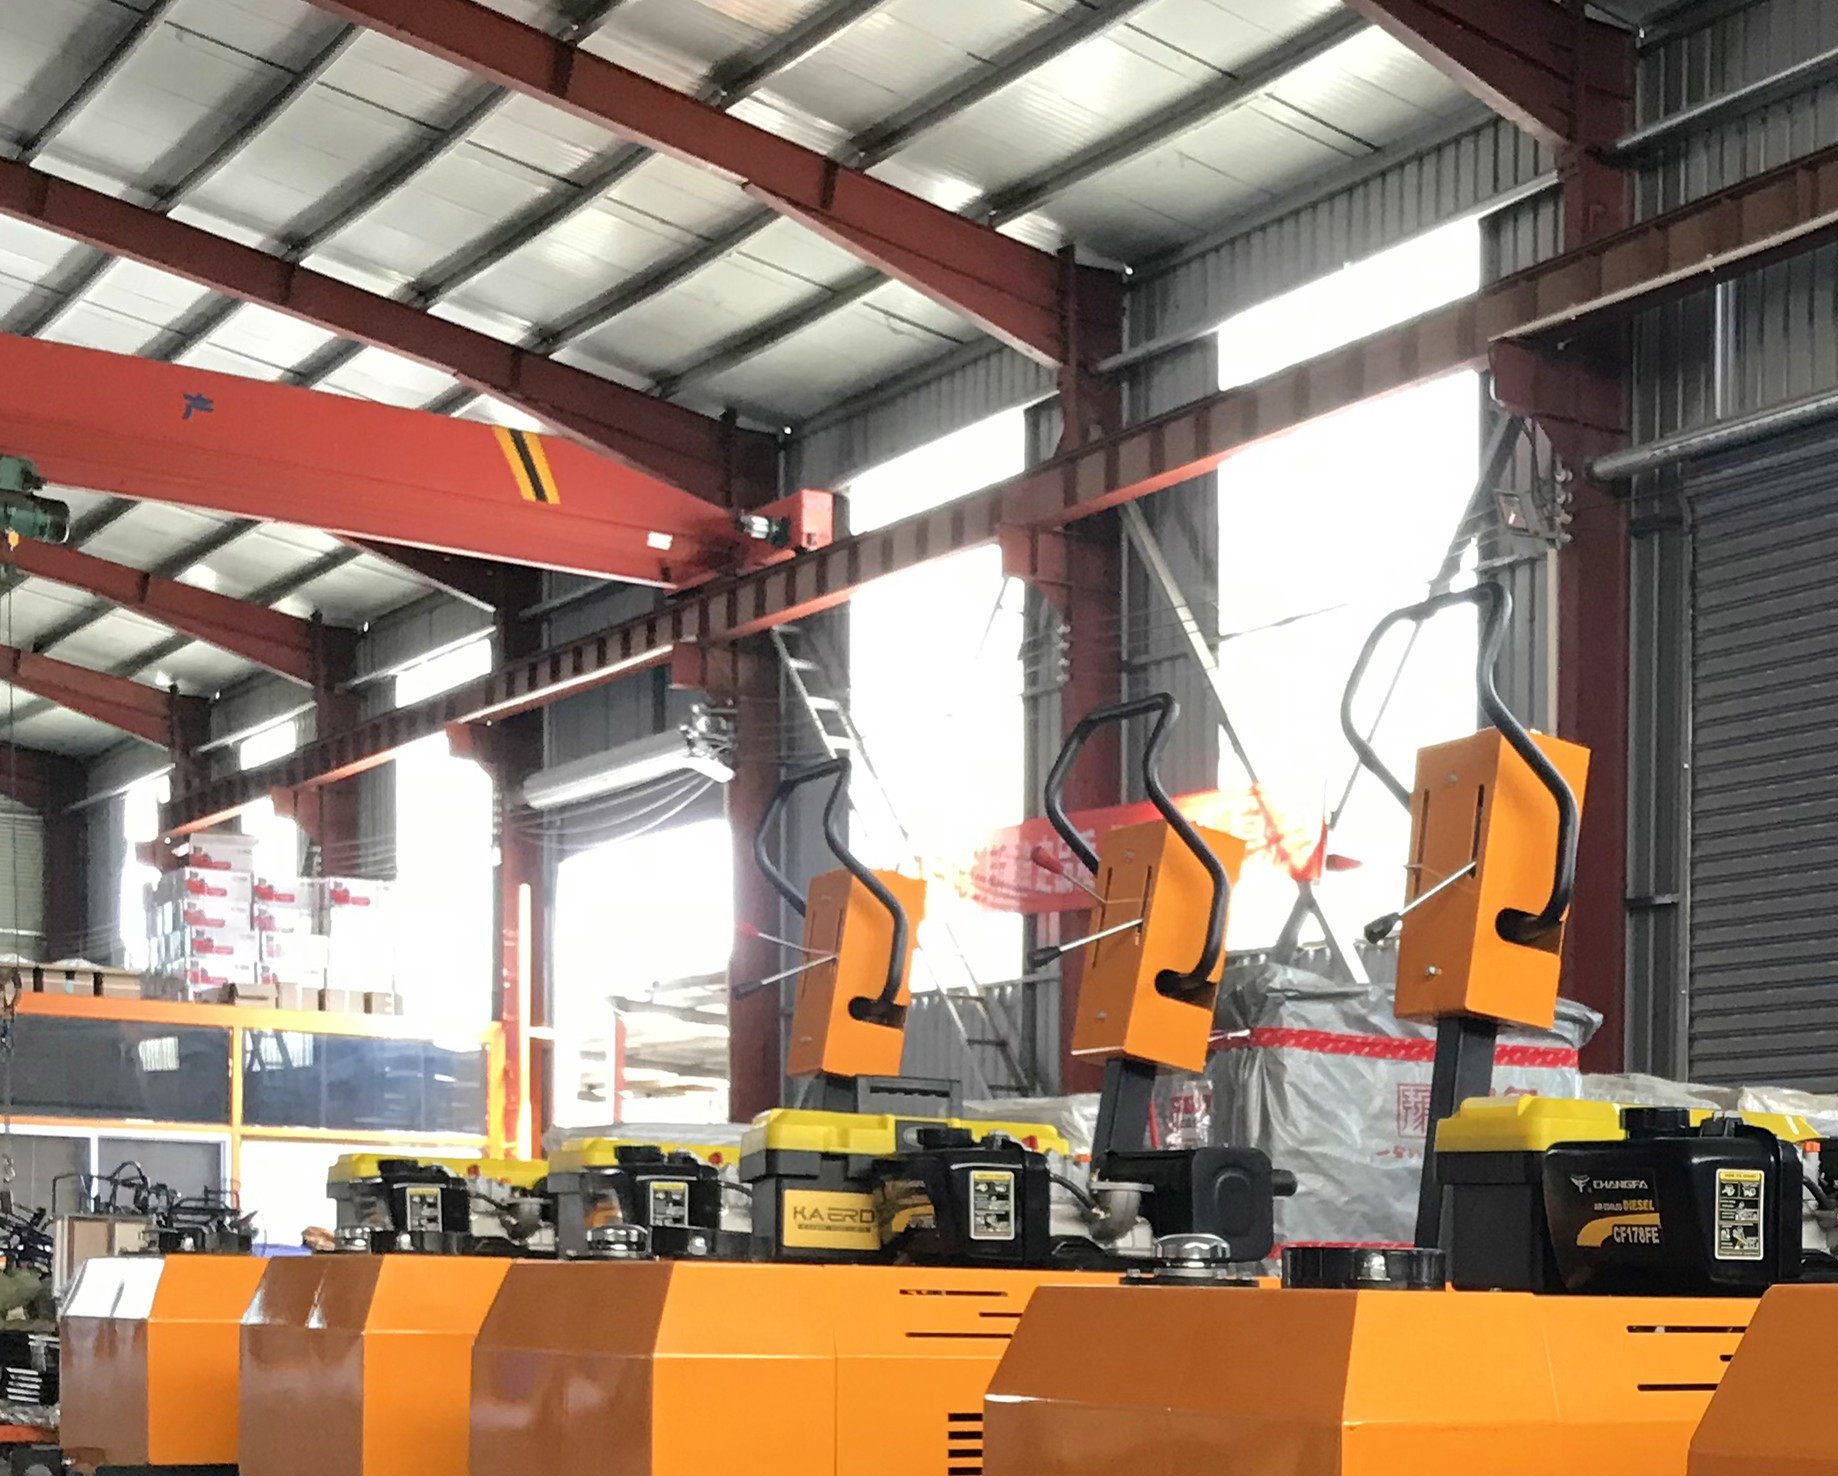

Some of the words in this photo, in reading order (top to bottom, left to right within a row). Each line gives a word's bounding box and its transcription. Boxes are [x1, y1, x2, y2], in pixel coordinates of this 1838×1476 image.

[1592, 1179, 1649, 1190] CHANGFA
[1622, 1199, 1655, 1211] DIESEL
[793, 1206, 875, 1224] KAERD
[1613, 1226, 1660, 1244] CF178FE
